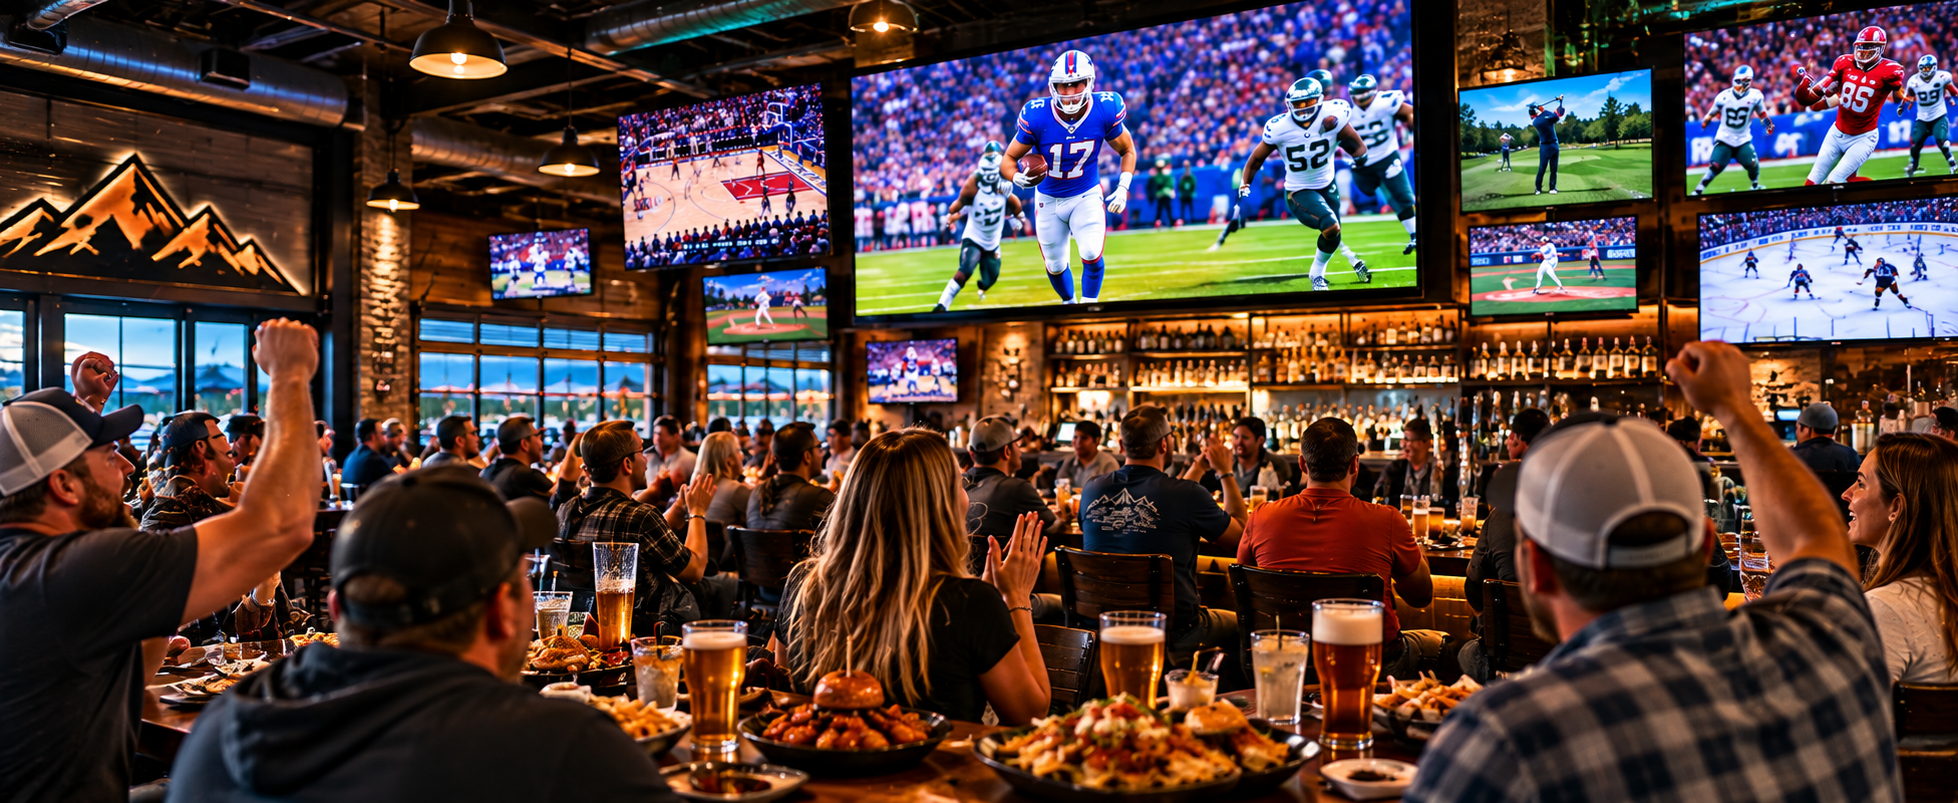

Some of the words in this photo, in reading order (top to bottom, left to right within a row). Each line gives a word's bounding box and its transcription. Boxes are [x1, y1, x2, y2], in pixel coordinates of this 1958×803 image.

[1840, 81, 1875, 113] 85
[1048, 139, 1095, 180] 17
[1286, 139, 1330, 173] 52
